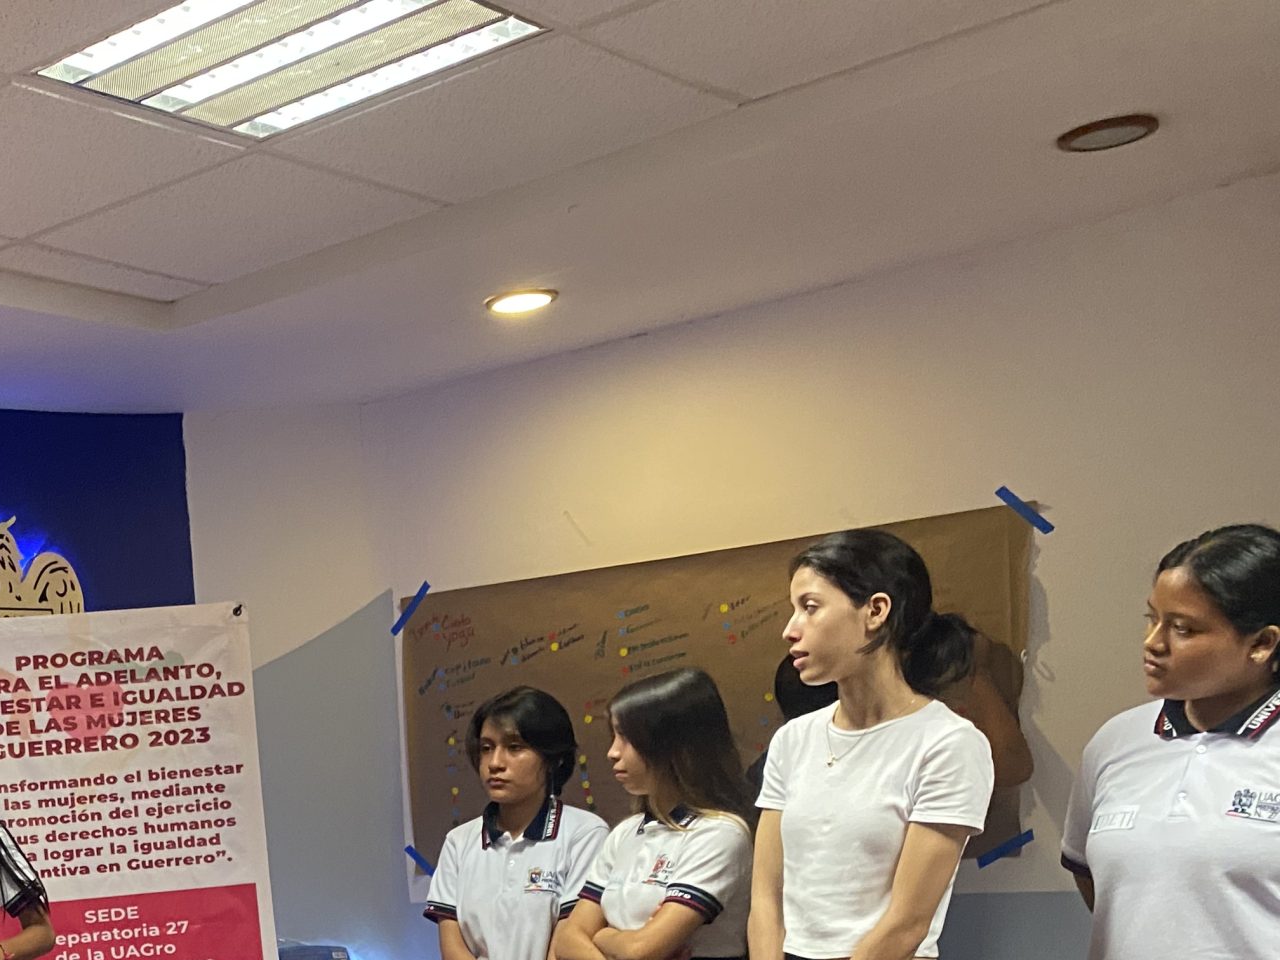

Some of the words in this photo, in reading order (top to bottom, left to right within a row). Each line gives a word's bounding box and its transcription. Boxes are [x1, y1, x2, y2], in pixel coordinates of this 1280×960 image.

[16, 646, 164, 671] PROGRAMA
[38, 675, 69, 690] EL
[76, 662, 222, 688] ADELANTO,
[90, 693, 106, 708] E
[112, 682, 246, 707] IGUALDAD
[30, 715, 78, 734] LAS
[86, 706, 202, 730] MUJERES
[148, 727, 211, 748] 2023
[124, 770, 141, 784] el
[148, 763, 244, 781] bienestar
[4, 799, 31, 810] las
[37, 789, 124, 810] mujeres,
[132, 782, 226, 801] mediante
[109, 805, 139, 819] del
[146, 797, 232, 818] ejercicio
[45, 825, 138, 843] derechos
[144, 817, 236, 834] humanos
[43, 846, 103, 863] lograr
[110, 843, 127, 854] la
[133, 833, 221, 854] igualdad
[97, 862, 121, 873] en
[84, 906, 139, 924] SEDE
[56, 924, 160, 947] eparatoria
[166, 921, 189, 935] 27
[111, 943, 177, 960] UAGro
